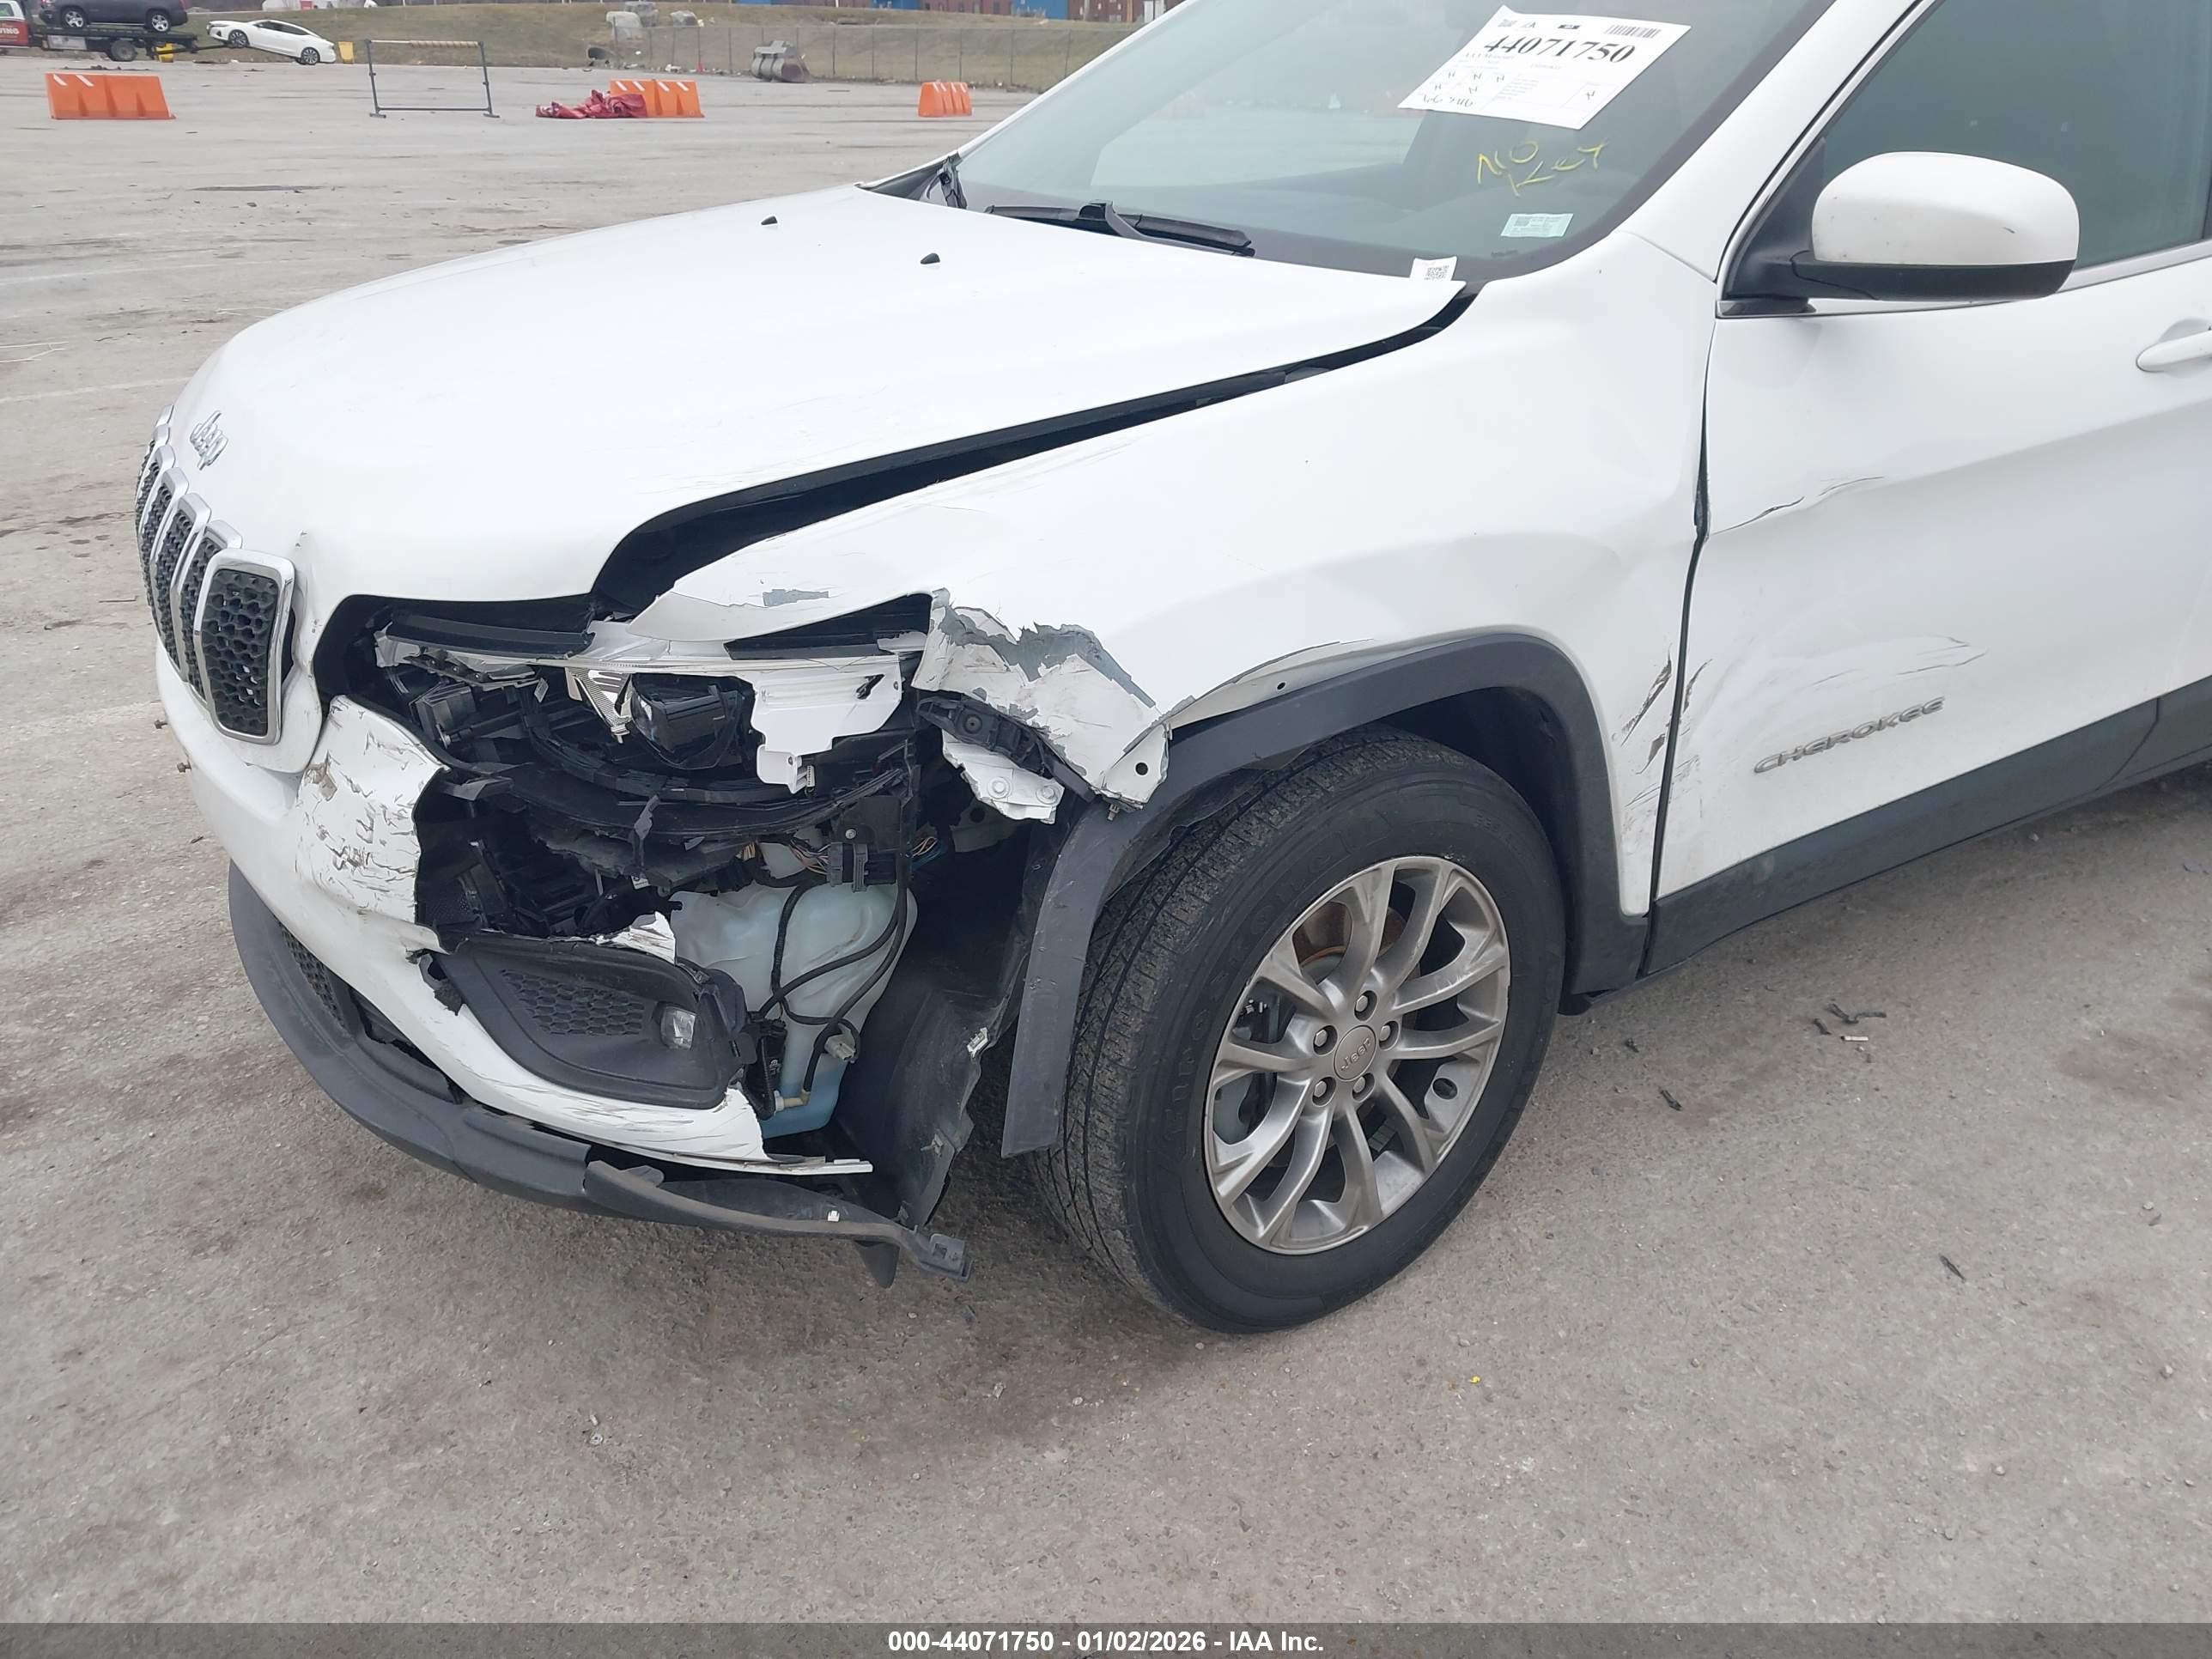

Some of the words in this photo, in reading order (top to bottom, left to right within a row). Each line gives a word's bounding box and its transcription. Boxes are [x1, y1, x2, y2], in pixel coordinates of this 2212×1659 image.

[1484, 35, 1636, 64] 44071750
[1477, 141, 1540, 185] NO
[190, 410, 228, 471] Jeep
[1754, 696, 1945, 773] CHEROKEE
[1340, 1037, 1371, 1072] Jeep
